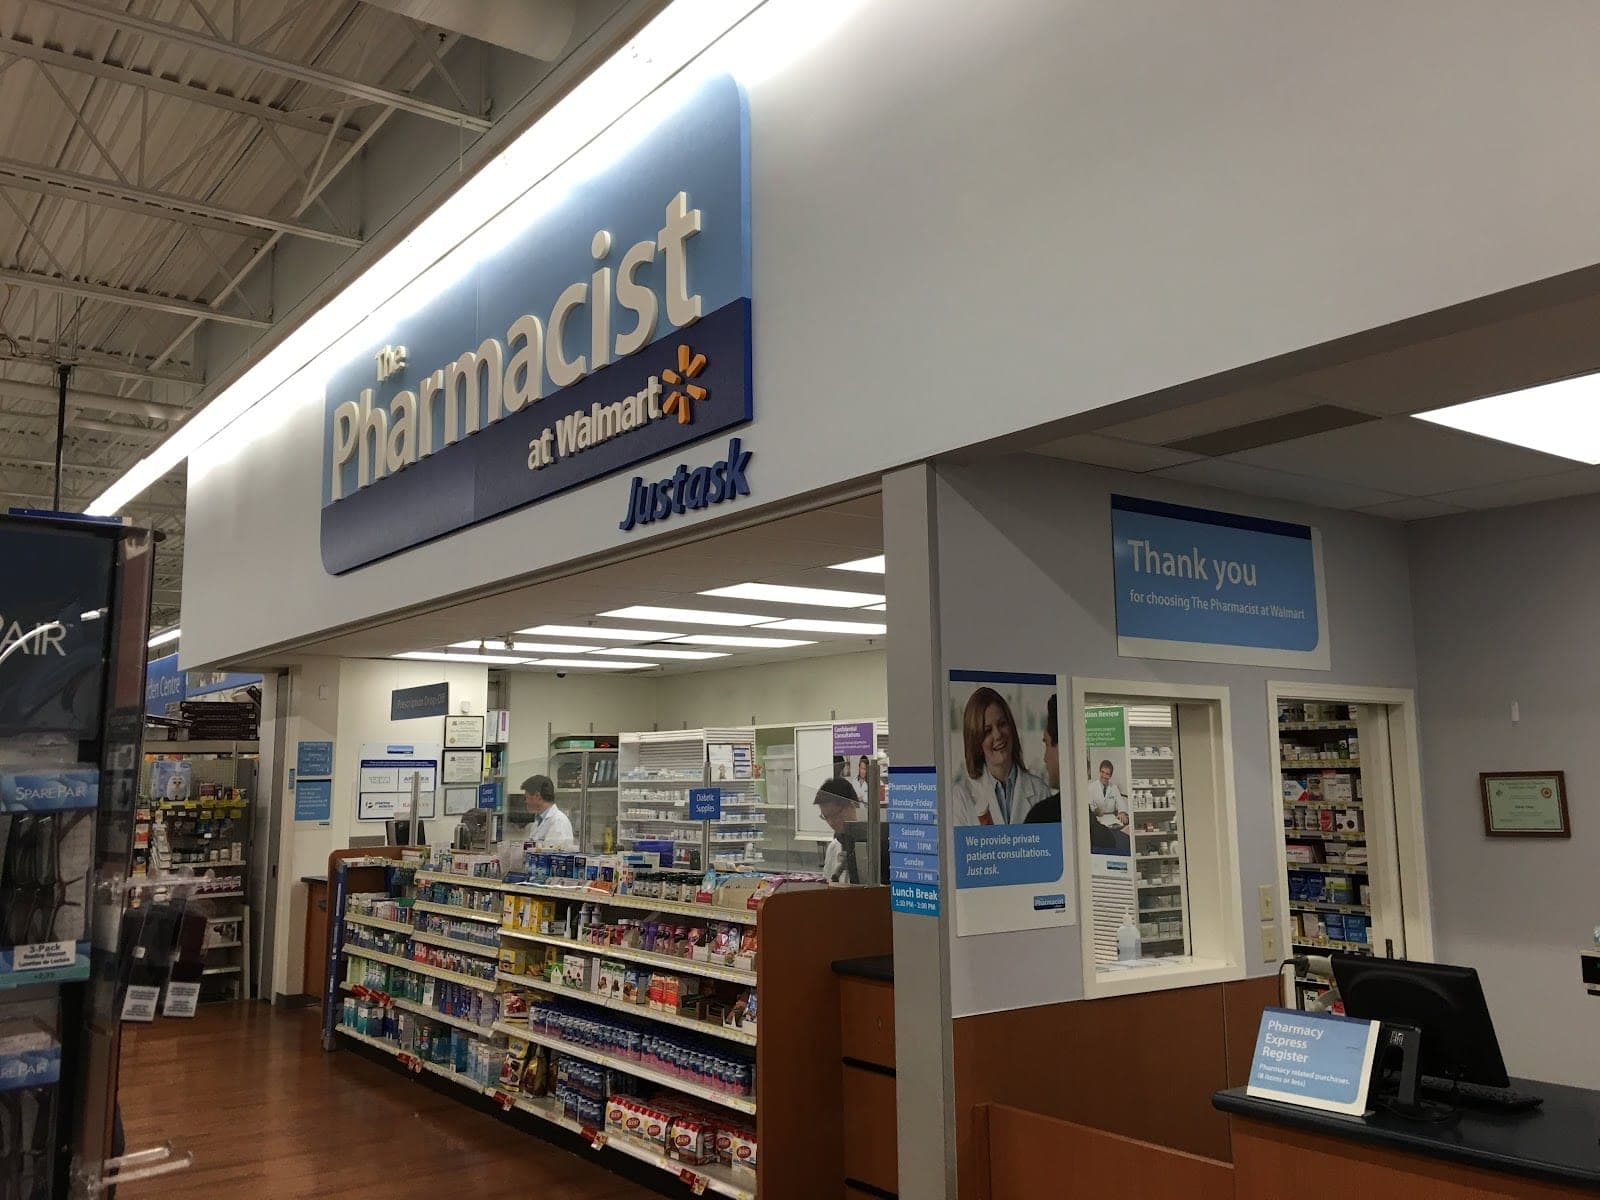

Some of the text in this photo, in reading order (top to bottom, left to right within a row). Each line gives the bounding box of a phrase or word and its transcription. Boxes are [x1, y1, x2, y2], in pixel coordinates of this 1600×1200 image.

[331, 191, 701, 502] Pharmacist
[375, 345, 406, 382] The
[528, 375, 662, 470] at Walmart
[1127, 539, 1257, 590] Thank you
[1130, 589, 1305, 620] for choosing The Pharmacist at Walmart
[889, 783, 936, 792] Pharmacy Hours
[892, 799, 933, 808] Monday-Friday
[901, 828, 925, 838] Saturday
[965, 833, 1040, 848] We provide private
[904, 858, 924, 868] Sunday
[966, 848, 1051, 863] patient consultations.
[899, 871, 908, 879] AM
[966, 864, 999, 876] Just ask.
[892, 887, 938, 900] Lunch Break
[1268, 1020, 1324, 1039] Pharmacy
[1265, 1033, 1308, 1048] Express
[1262, 1046, 1309, 1062] Register
[1259, 1063, 1290, 1076] Pharmacy
[1291, 1069, 1315, 1079] related
[1265, 1073, 1282, 1082] items
[1283, 1076, 1290, 1084] or
